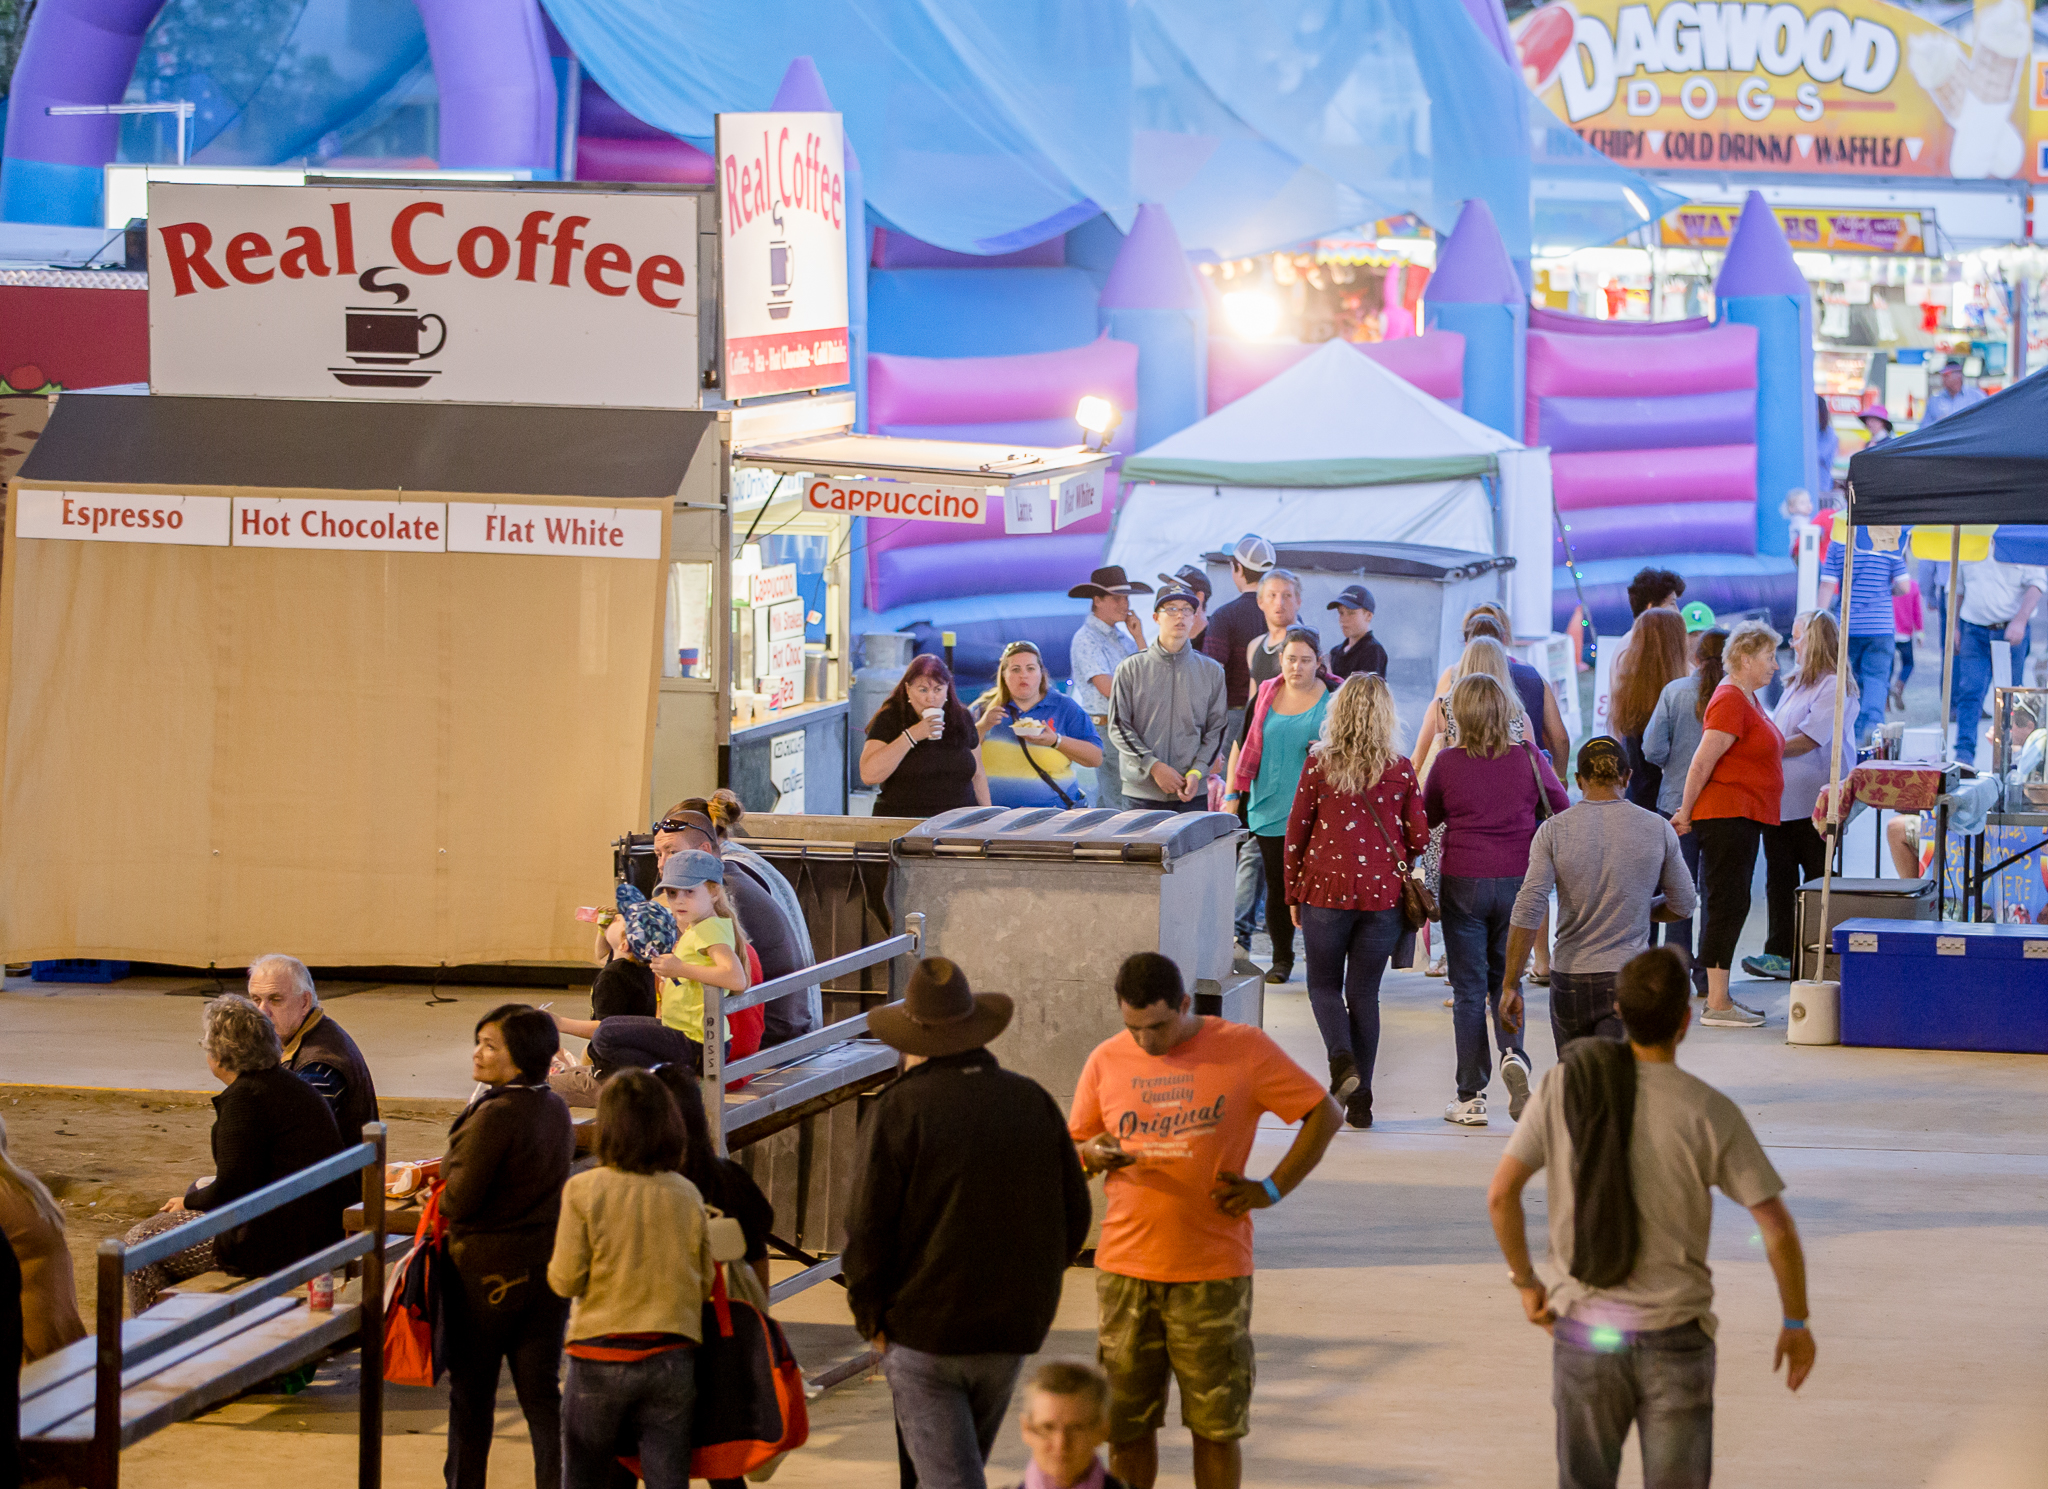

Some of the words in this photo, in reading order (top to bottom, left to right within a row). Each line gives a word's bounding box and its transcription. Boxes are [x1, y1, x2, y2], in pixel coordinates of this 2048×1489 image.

[1558, 1, 1900, 123] DAGWOOD
[1627, 76, 1824, 122] DOGS
[1664, 131, 1713, 162] COLD
[1719, 133, 1795, 164] DRINKS
[1814, 136, 1906, 168] WAFFLES
[724, 129, 773, 238] Real
[778, 126, 842, 231] Coffee
[158, 201, 359, 298] Real
[390, 201, 686, 309] Coffee
[808, 481, 979, 519] Cappuccino
[1076, 482, 1094, 510] White
[62, 498, 185, 535] Espresso
[240, 508, 295, 538] Hot
[300, 510, 440, 542] Chocolate
[485, 515, 536, 544] Flat
[545, 516, 625, 549] White
[1119, 1094, 1225, 1139] Original
